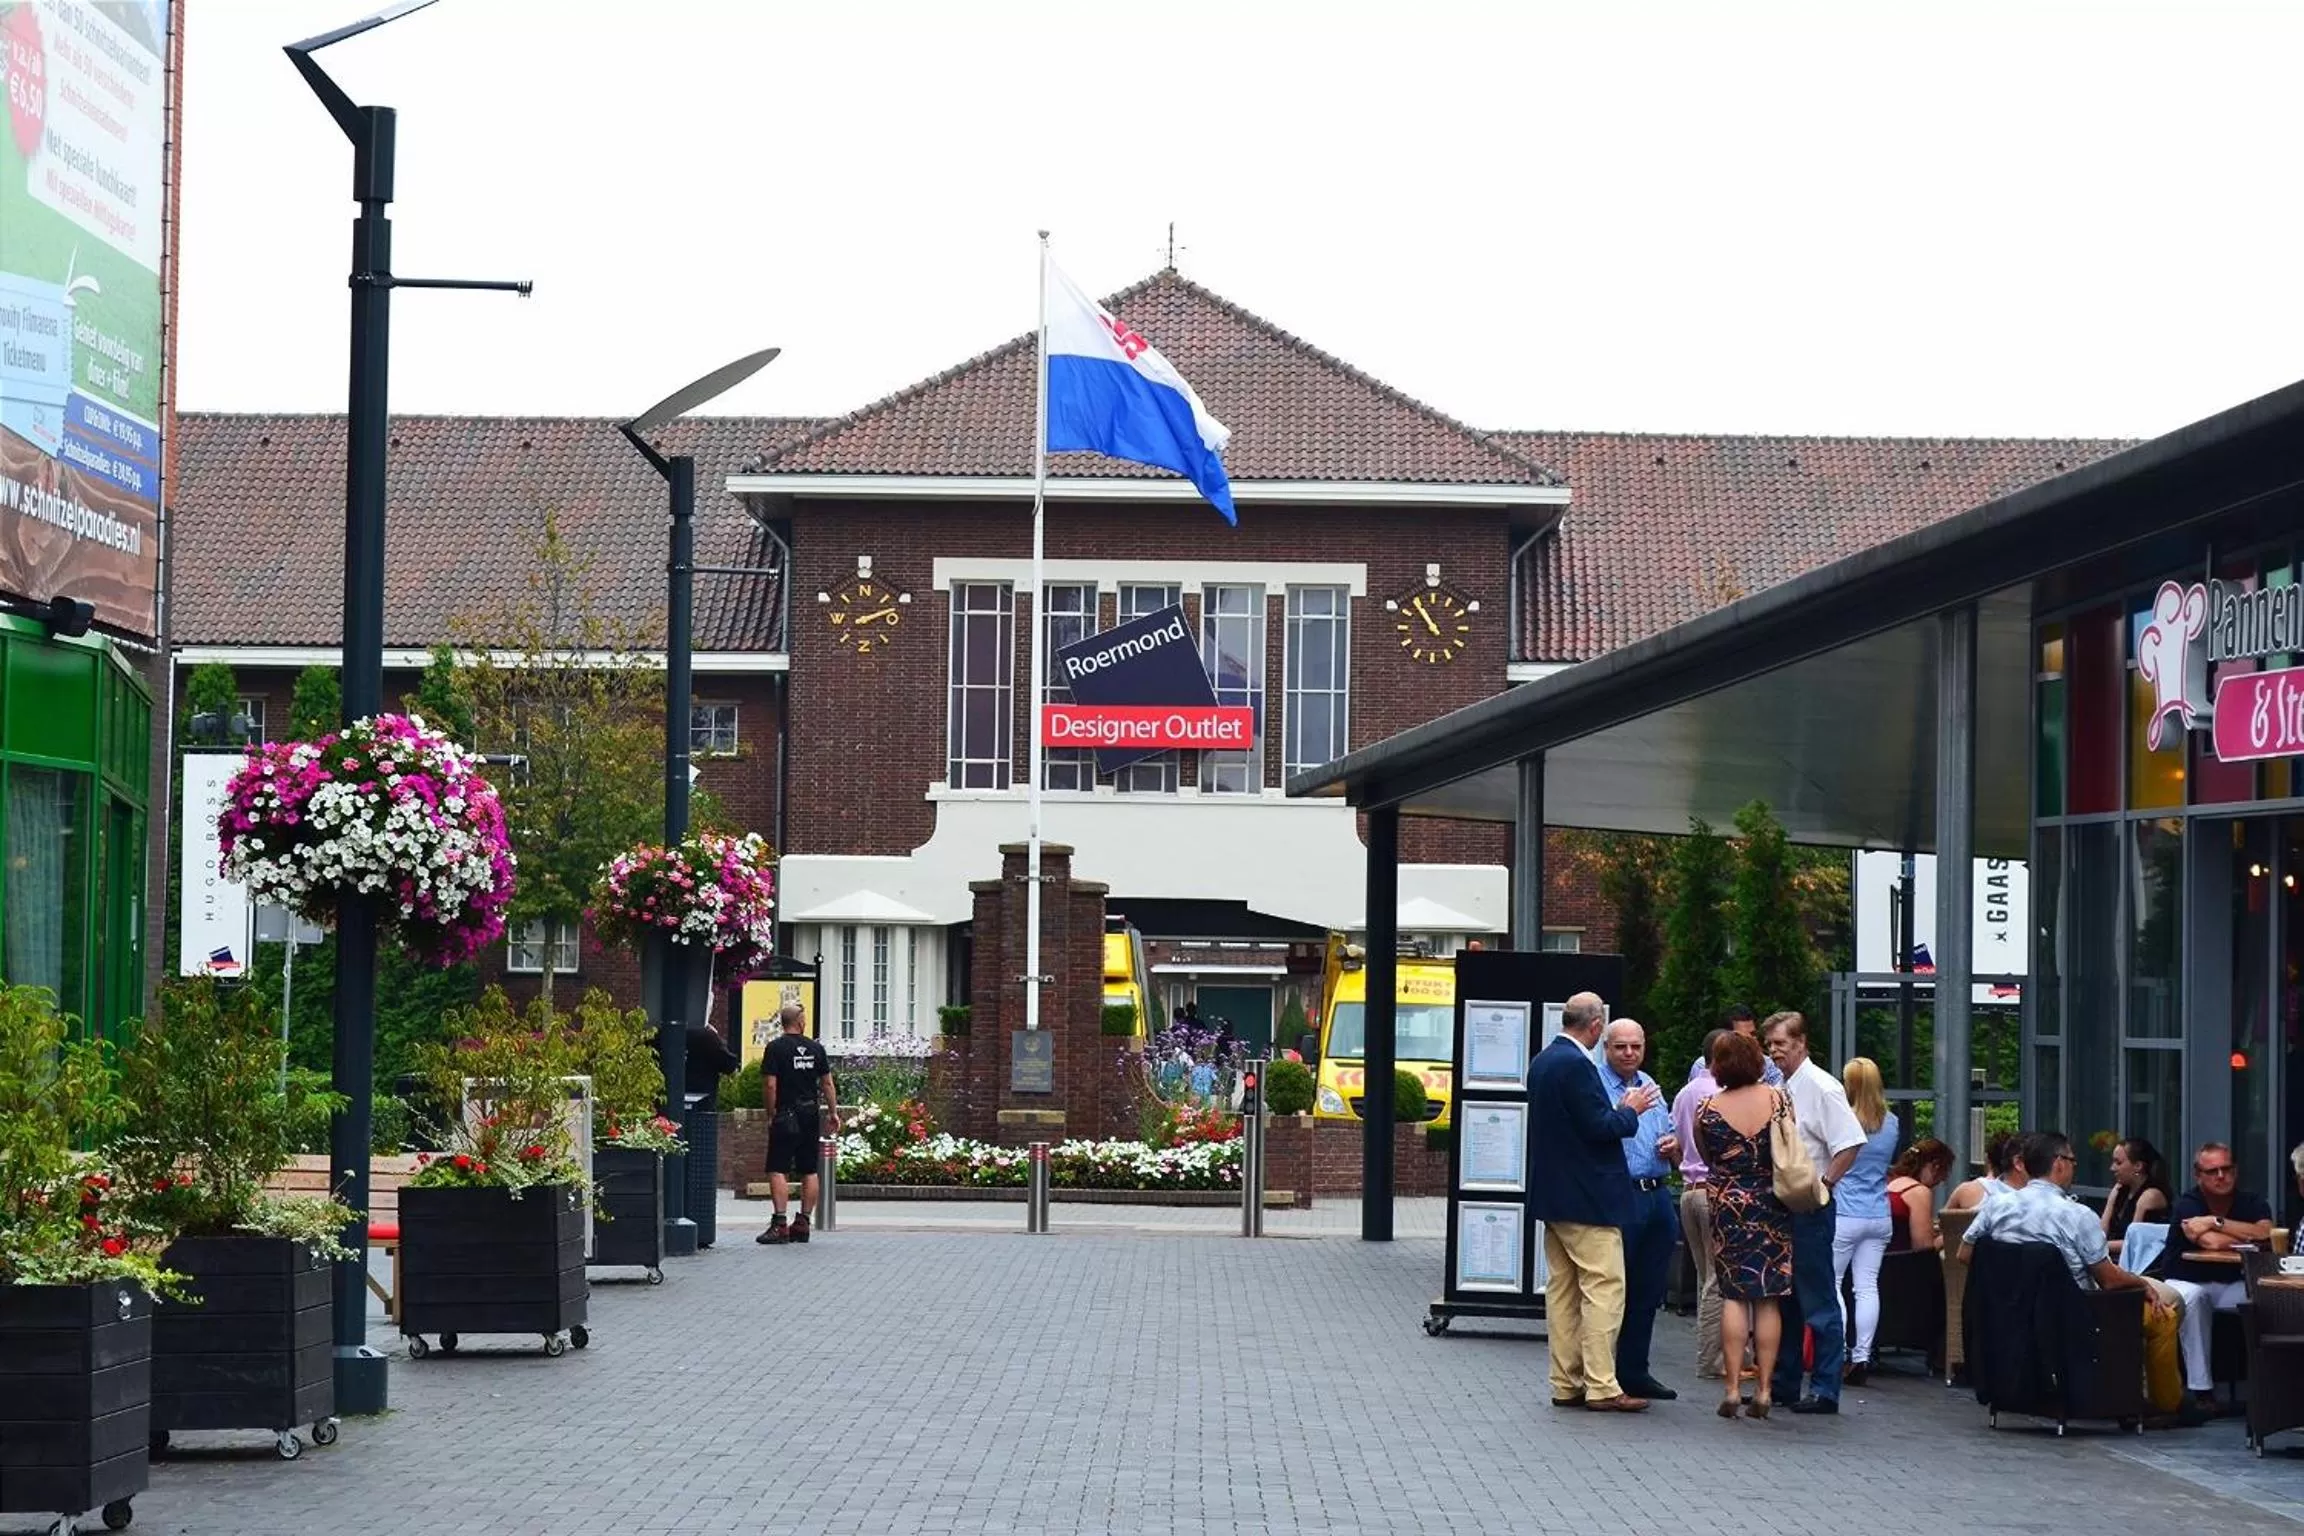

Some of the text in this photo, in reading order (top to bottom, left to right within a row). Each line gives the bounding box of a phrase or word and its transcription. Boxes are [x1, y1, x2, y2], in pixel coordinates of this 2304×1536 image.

[10, 70, 43, 119] €6,50
[859, 584, 872, 597] N
[829, 612, 846, 625] W
[1065, 615, 1185, 680] Roermond
[1051, 713, 1243, 744] Designer Outlet
[204, 779, 217, 921] HUGO BOSS
